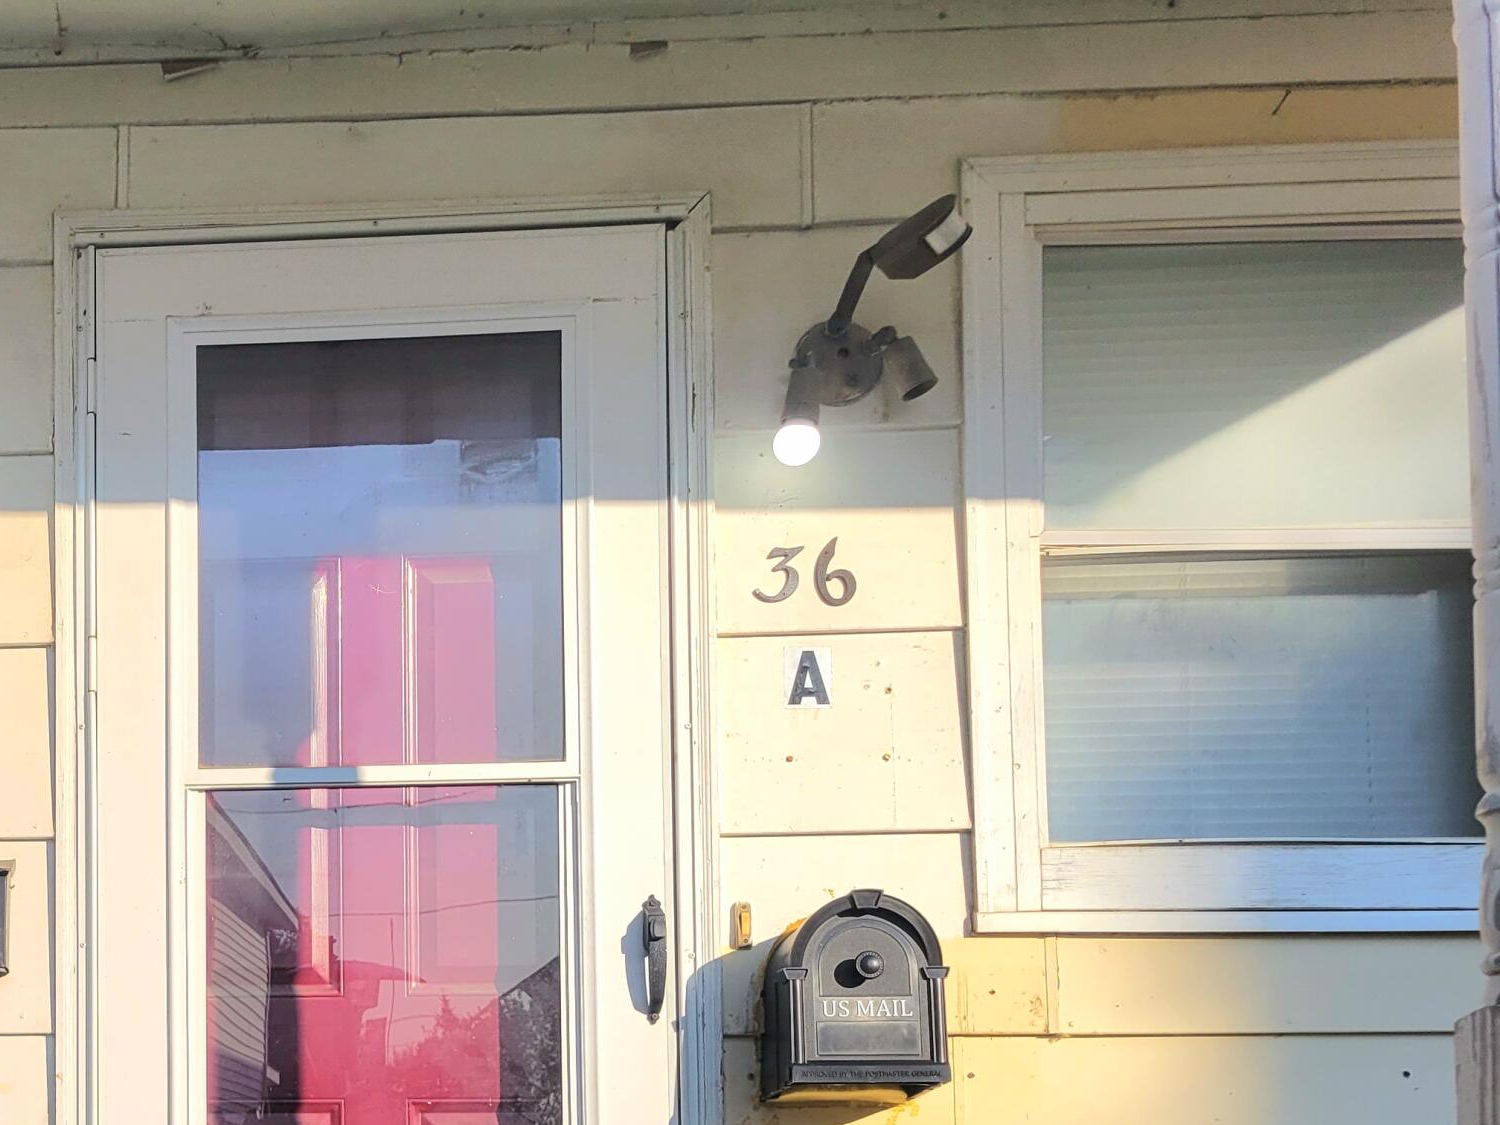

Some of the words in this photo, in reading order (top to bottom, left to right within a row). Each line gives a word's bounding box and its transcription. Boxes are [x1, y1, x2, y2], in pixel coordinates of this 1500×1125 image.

[751, 536, 857, 607] 36
[787, 650, 831, 705] A
[822, 999, 850, 1018] US
[856, 999, 914, 1018] MAIL
[865, 1070, 909, 1079] POSTMASTER
